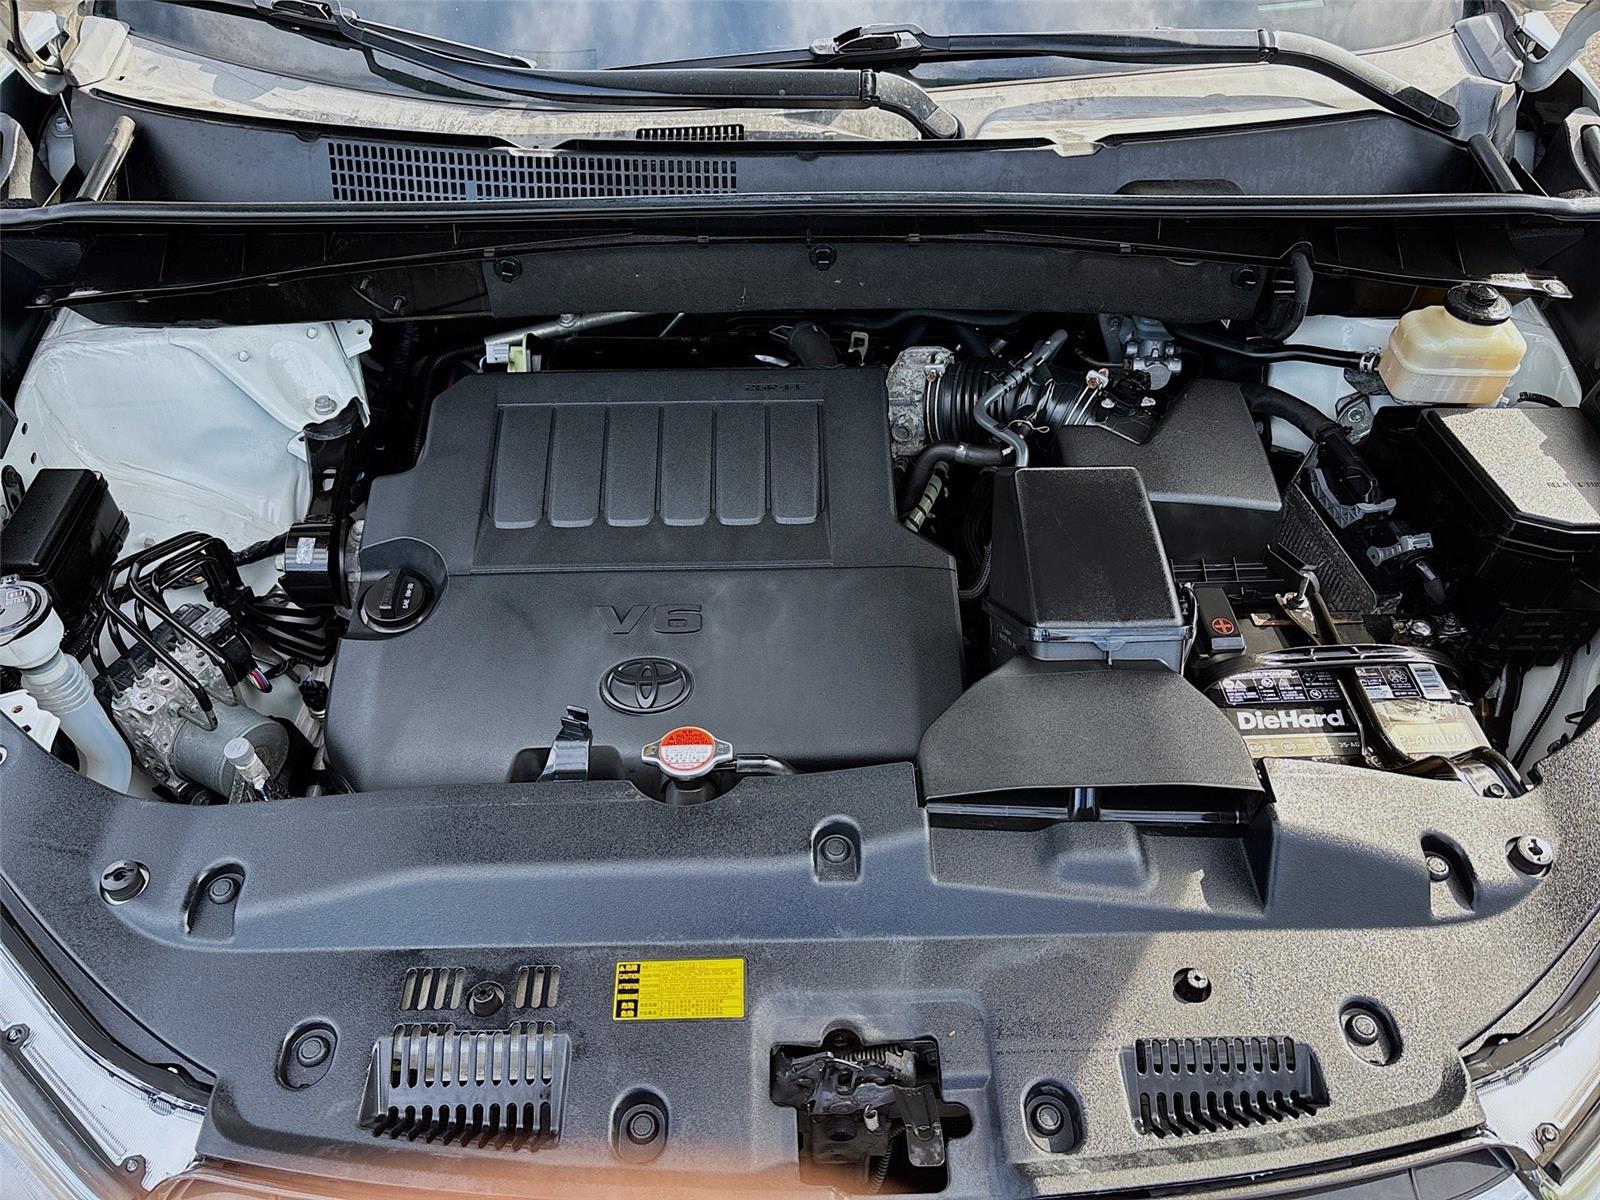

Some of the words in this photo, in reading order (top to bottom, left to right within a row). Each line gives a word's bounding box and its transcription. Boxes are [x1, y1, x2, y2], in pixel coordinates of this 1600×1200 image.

[402, 599, 410, 609] SAE
[595, 603, 703, 634] V6
[1236, 708, 1346, 730] DieHard
[1397, 734, 1470, 746] PLATINUM
